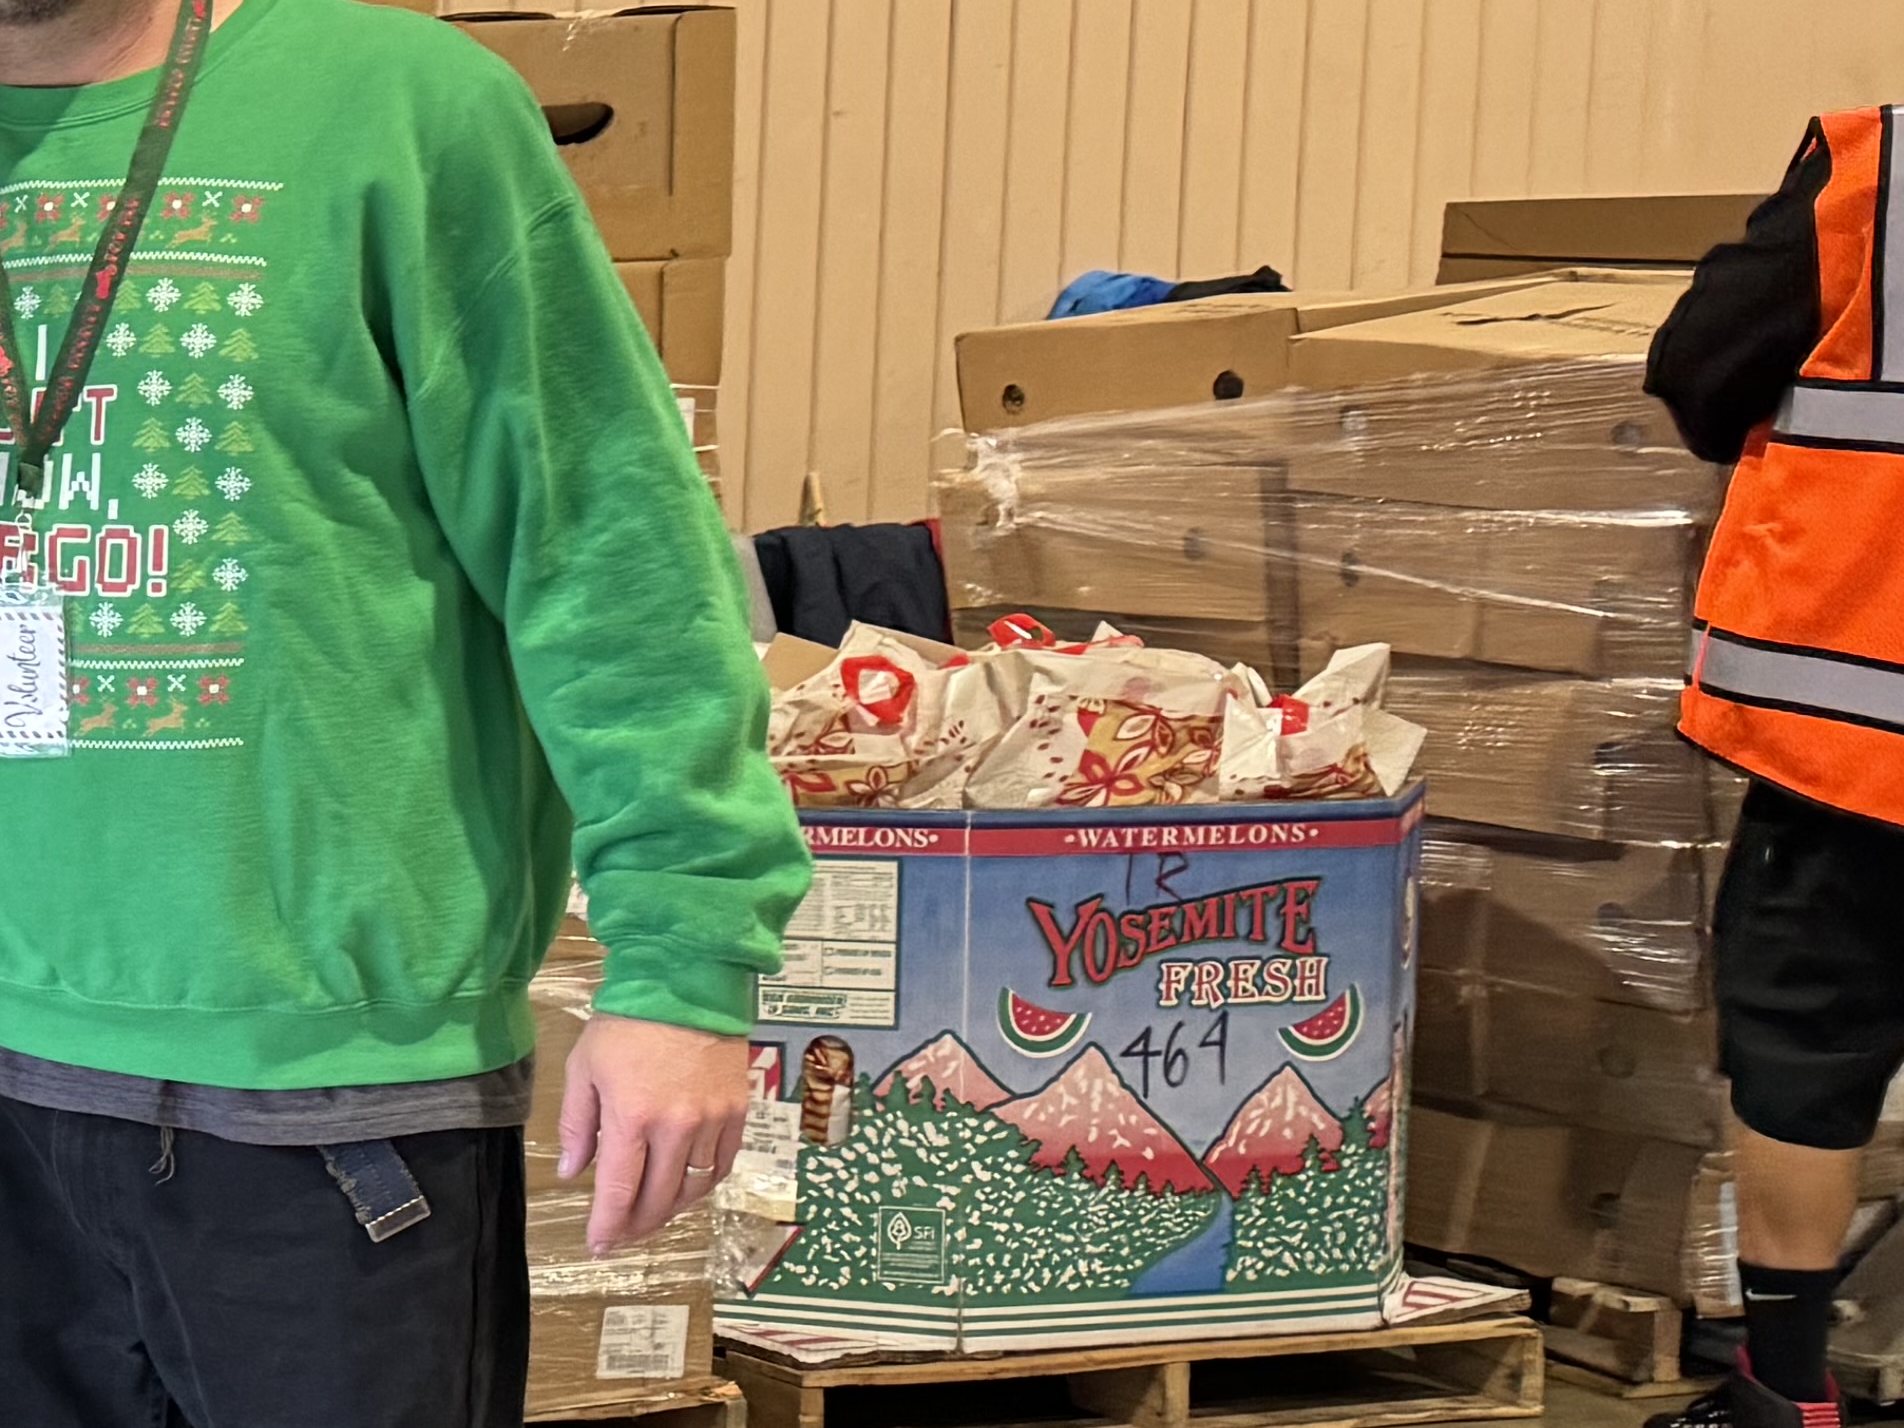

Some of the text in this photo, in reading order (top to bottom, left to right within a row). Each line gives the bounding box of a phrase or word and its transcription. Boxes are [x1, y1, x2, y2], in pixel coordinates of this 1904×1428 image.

[4, 623, 44, 728] Volunteer
[800, 825, 929, 848] RMELONS
[1075, 823, 1307, 849] WATERMELONS
[1025, 876, 1323, 988] YOSEMITE
[1157, 954, 1331, 1009] FRESH
[1120, 1009, 1229, 1100] 464
